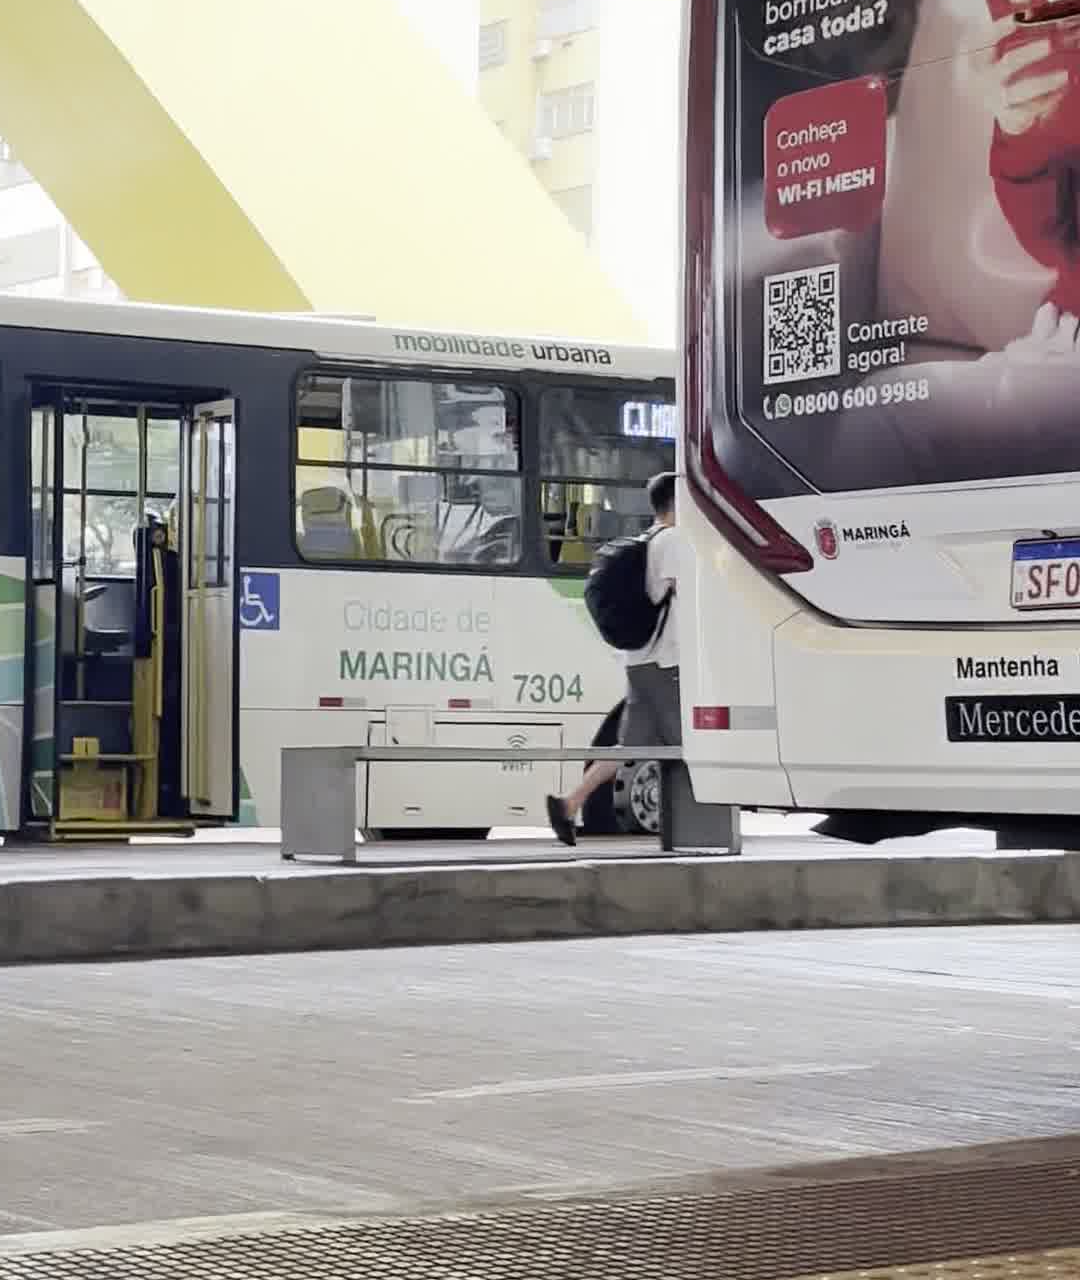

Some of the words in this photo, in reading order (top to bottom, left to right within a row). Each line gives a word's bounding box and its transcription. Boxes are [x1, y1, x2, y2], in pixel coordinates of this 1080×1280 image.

[763, 24, 815, 56] casa
[820, 0, 888, 39] toda?
[776, 119, 848, 150] Conheça
[777, 162, 789, 177] o
[791, 152, 831, 175] novo
[776, 179, 822, 206] WI-FI
[825, 167, 876, 195] MESH
[847, 315, 929, 343] Contrate
[393, 334, 525, 359] mobilidade
[530, 341, 611, 365] urbana
[847, 341, 906, 372] agora!
[793, 390, 839, 416] 0800
[842, 385, 877, 409] 600
[880, 378, 929, 405] 9988
[842, 520, 911, 542] MARINGÁ
[343, 599, 448, 632] Cidade
[456, 602, 491, 633] de
[338, 645, 494, 682] MARINGÁ
[956, 655, 1059, 679] Mantenha
[512, 672, 584, 703] 7304
